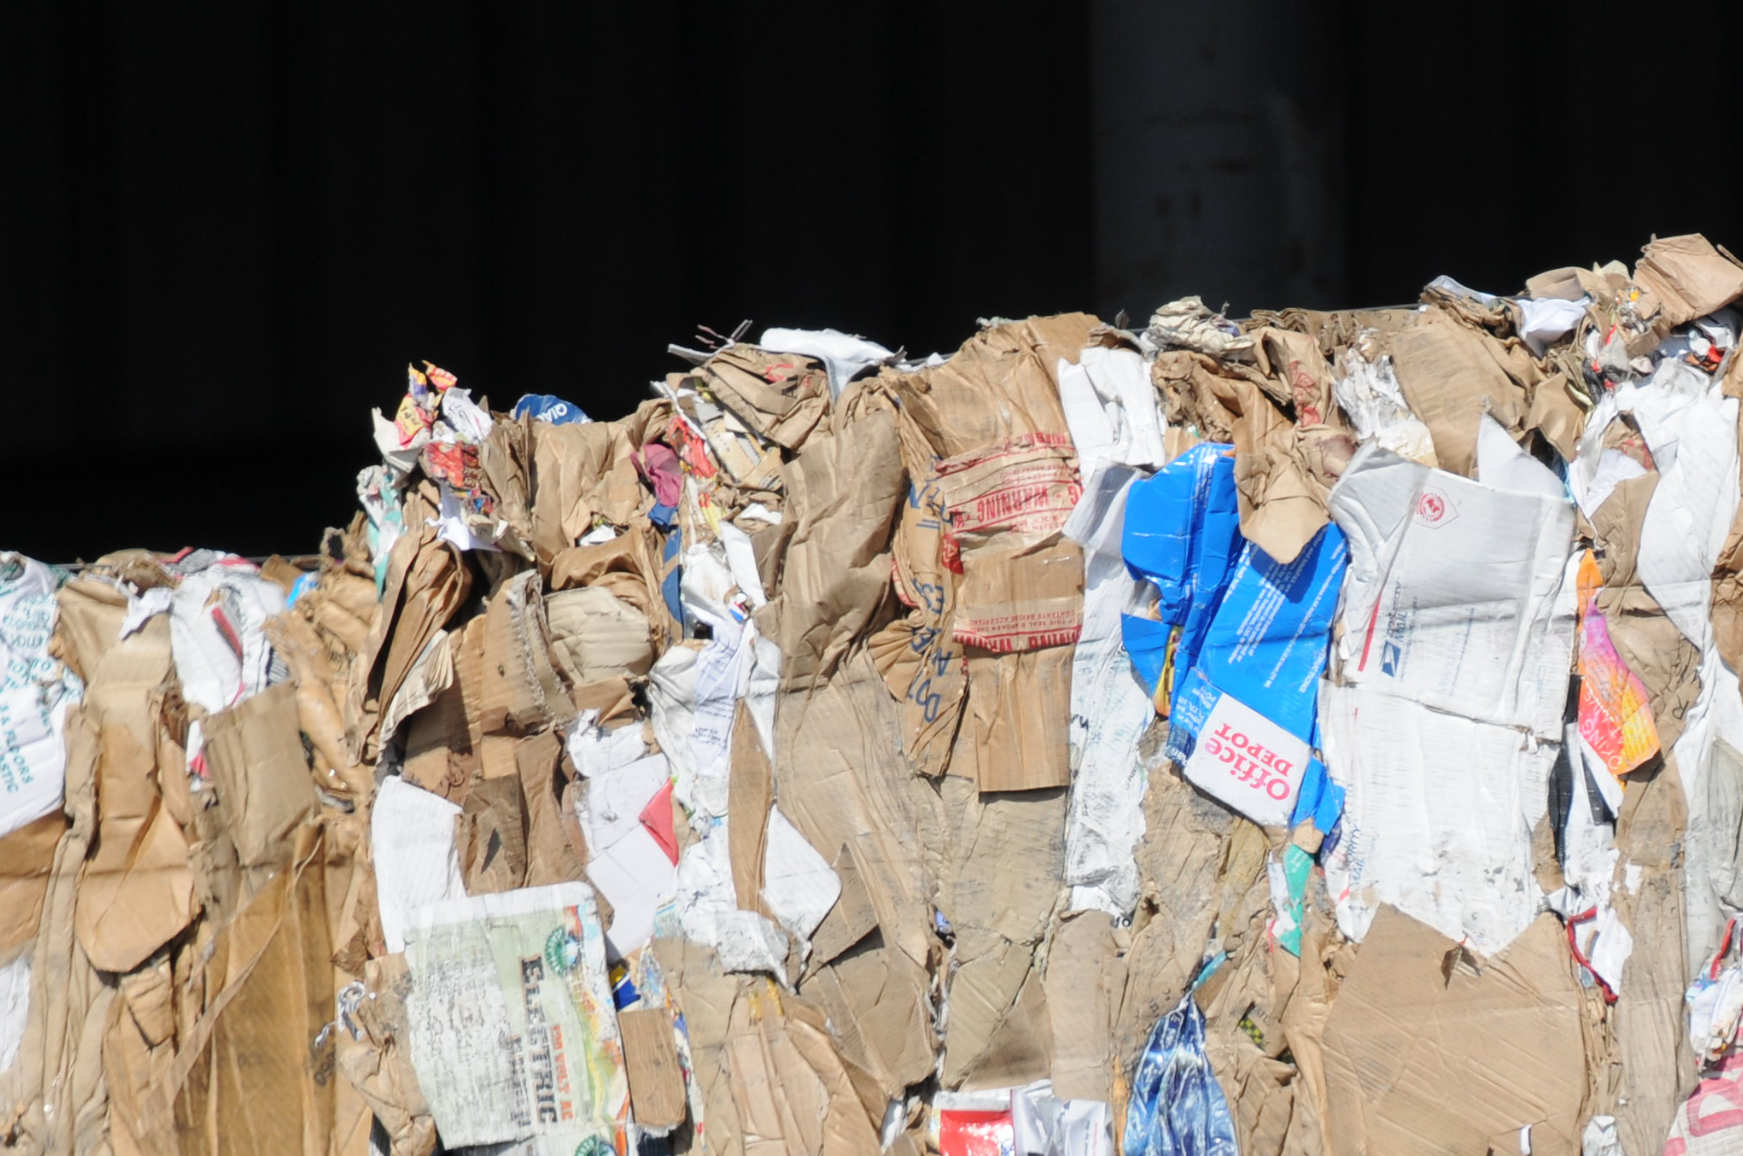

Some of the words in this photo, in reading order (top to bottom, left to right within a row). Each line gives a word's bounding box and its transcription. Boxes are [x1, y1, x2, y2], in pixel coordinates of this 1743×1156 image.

[976, 484, 1049, 523] WARNING
[4, 729, 34, 785] FLOORS
[1205, 736, 1291, 801] Office
[1214, 722, 1293, 777] DEPOT
[522, 955, 558, 1123] ELECTRIC
[555, 1053, 570, 1094] VOLT
[560, 1100, 573, 1121] AC
